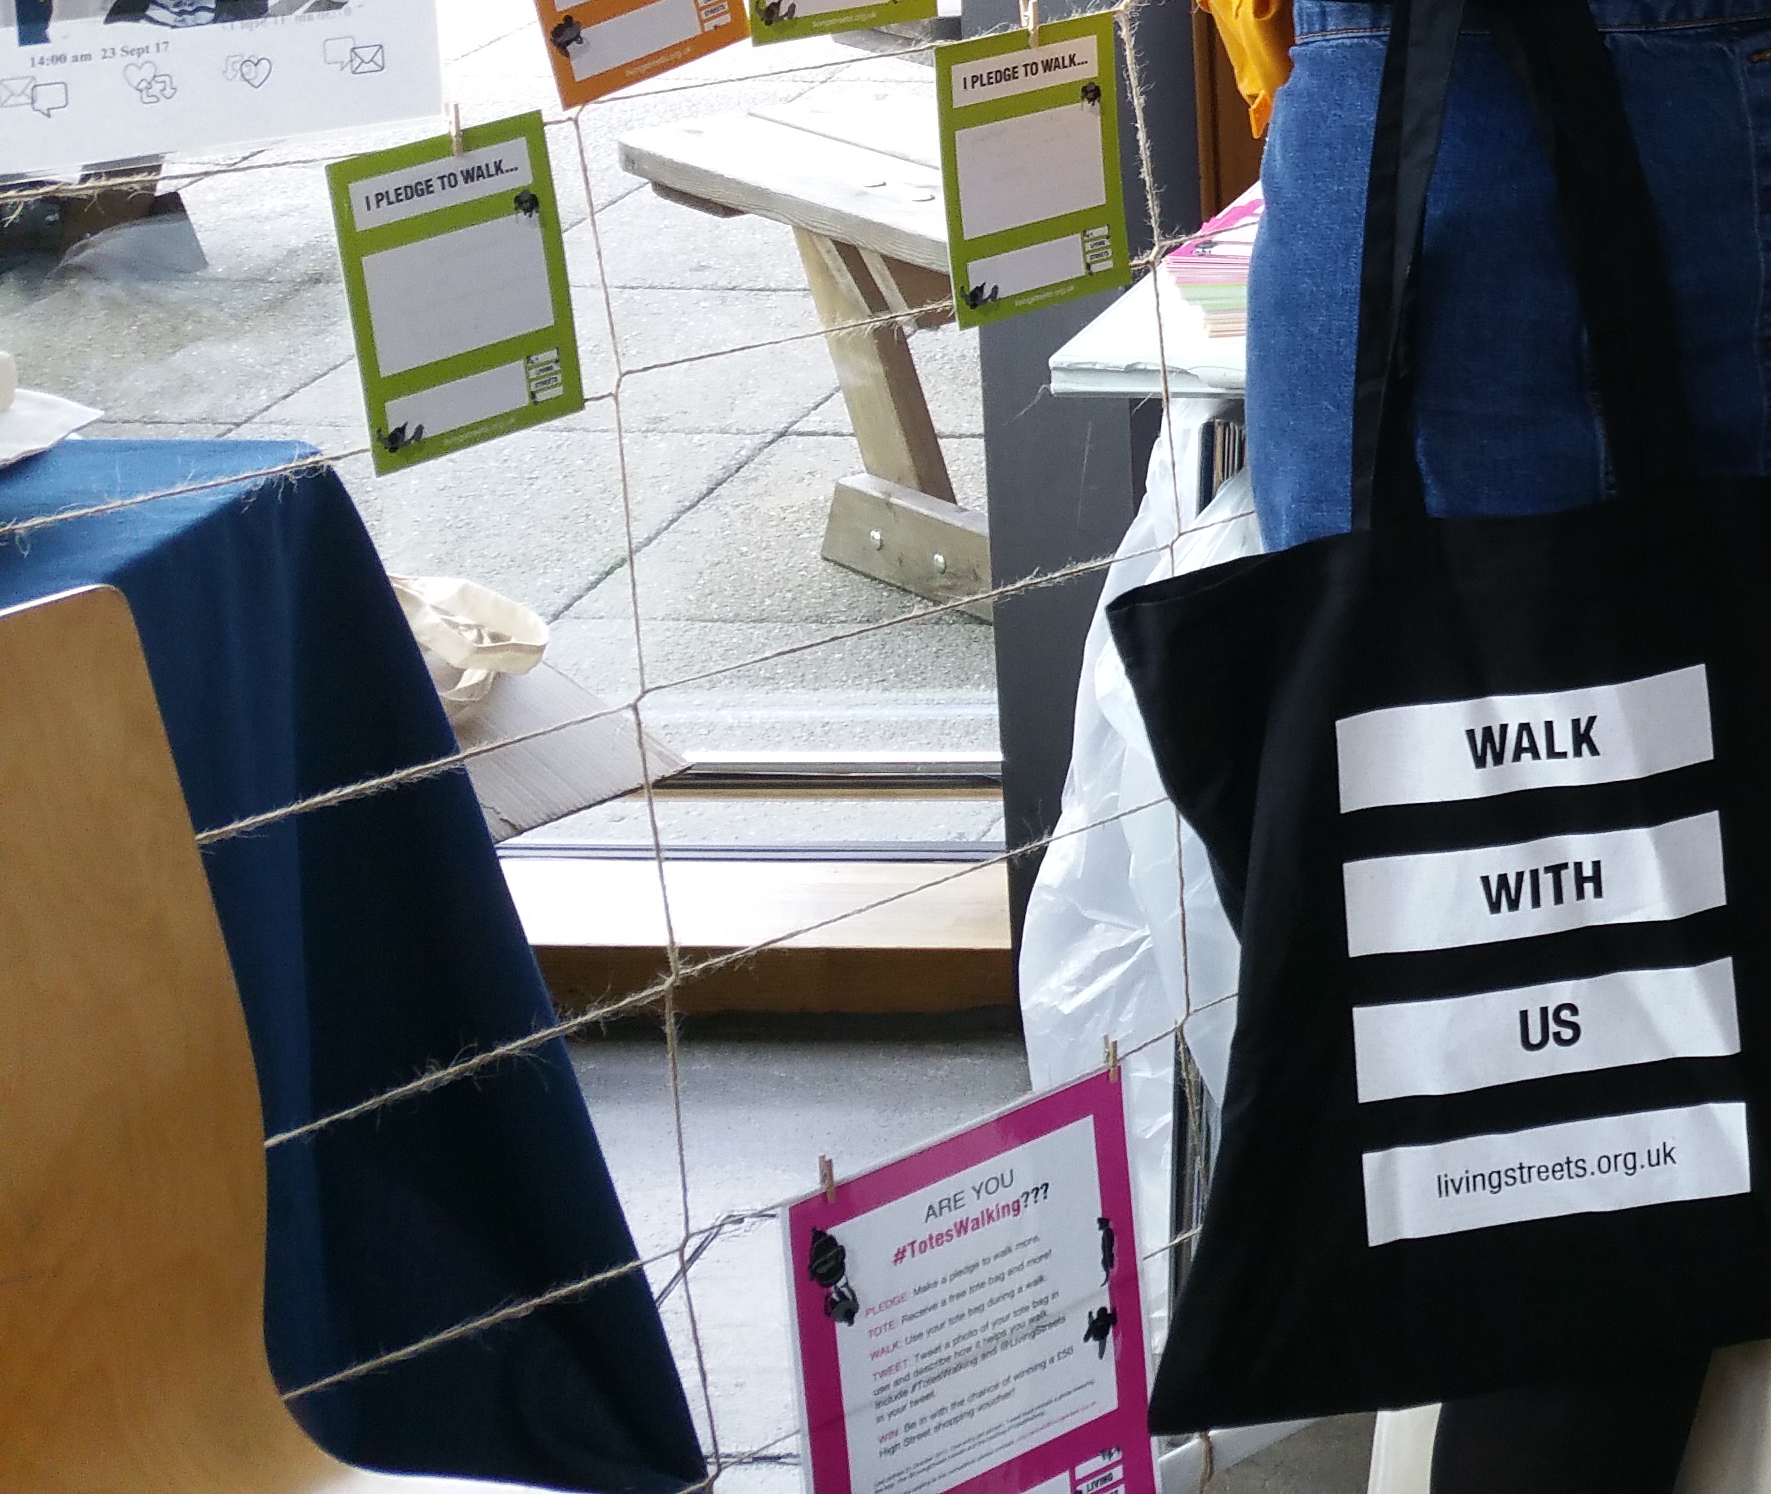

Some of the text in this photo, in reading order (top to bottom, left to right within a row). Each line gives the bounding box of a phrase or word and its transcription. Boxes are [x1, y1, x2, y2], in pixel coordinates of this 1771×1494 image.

[30, 55, 67, 68] 14:00
[100, 47, 116, 59] 23
[120, 43, 151, 58] Sept
[155, 41, 170, 54] 17
[963, 53, 1088, 90] I PLEDGE TO WALK...
[365, 158, 519, 211] I PLEDGE TO WALK...
[1464, 715, 1601, 771] WALK
[1479, 859, 1605, 916] WITH
[1518, 1001, 1583, 1053] US
[924, 1169, 1015, 1223] ARE YOU
[1436, 1141, 1678, 1199] livingstreets.org.uk
[892, 1182, 1050, 1266] #TotesWalking???
